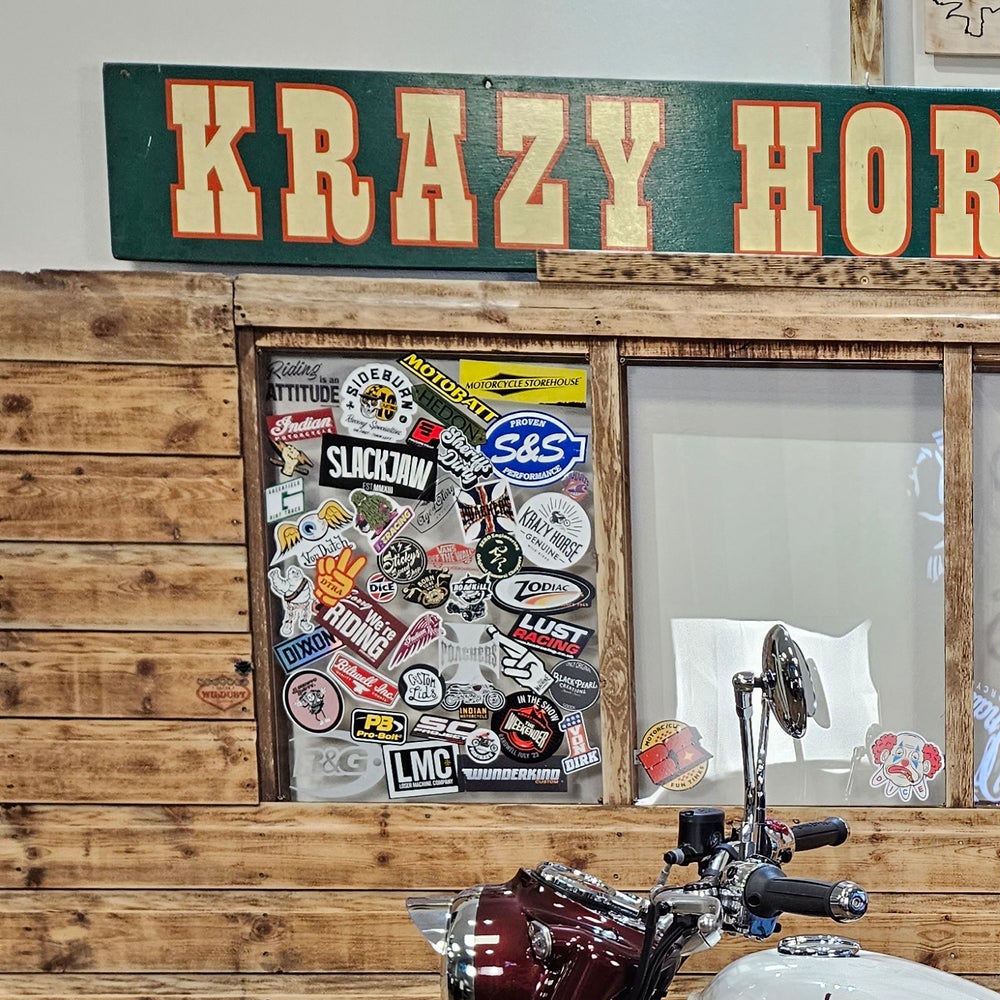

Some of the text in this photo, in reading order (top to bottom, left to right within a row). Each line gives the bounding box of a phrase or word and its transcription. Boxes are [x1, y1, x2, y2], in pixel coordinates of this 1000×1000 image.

[165, 78, 665, 251] KRAZY
[268, 360, 321, 380] Riding
[466, 377, 579, 389] MOTORCYCLE STOREHOUSE
[268, 383, 339, 403] ATTITUDE
[346, 368, 413, 410] SIDEBURN
[403, 354, 499, 422] MOTOBATT
[270, 416, 333, 435] Indian
[418, 389, 480, 442] HEDON
[510, 418, 547, 428] PROVEN
[274, 428, 333, 441] MOTORCYCLE
[491, 433, 567, 463] S&S
[327, 446, 433, 490] SLACKJAW
[502, 464, 561, 480] PERFORMANCE
[363, 482, 373, 490] EST
[319, 535, 353, 558] Dutch
[519, 506, 553, 537] KRAZY
[550, 531, 583, 563] HORSE
[526, 533, 559, 560] GENUINE
[514, 581, 569, 602] ZODIAC
[323, 602, 389, 660] RIDING
[366, 609, 396, 641] We're
[519, 613, 588, 643] LUST
[282, 629, 337, 665] DIXXON
[513, 628, 580, 654] RACING
[517, 695, 525, 704] IN
[528, 695, 541, 706] THE
[541, 701, 559, 722] SHOW
[356, 730, 400, 740] Pro-Bolt
[364, 714, 394, 731] PB
[504, 712, 549, 748] WEEKENDER
[394, 748, 453, 783] LMC
[564, 750, 599, 771] DIRK
[462, 768, 560, 780] WUNDERKIND
